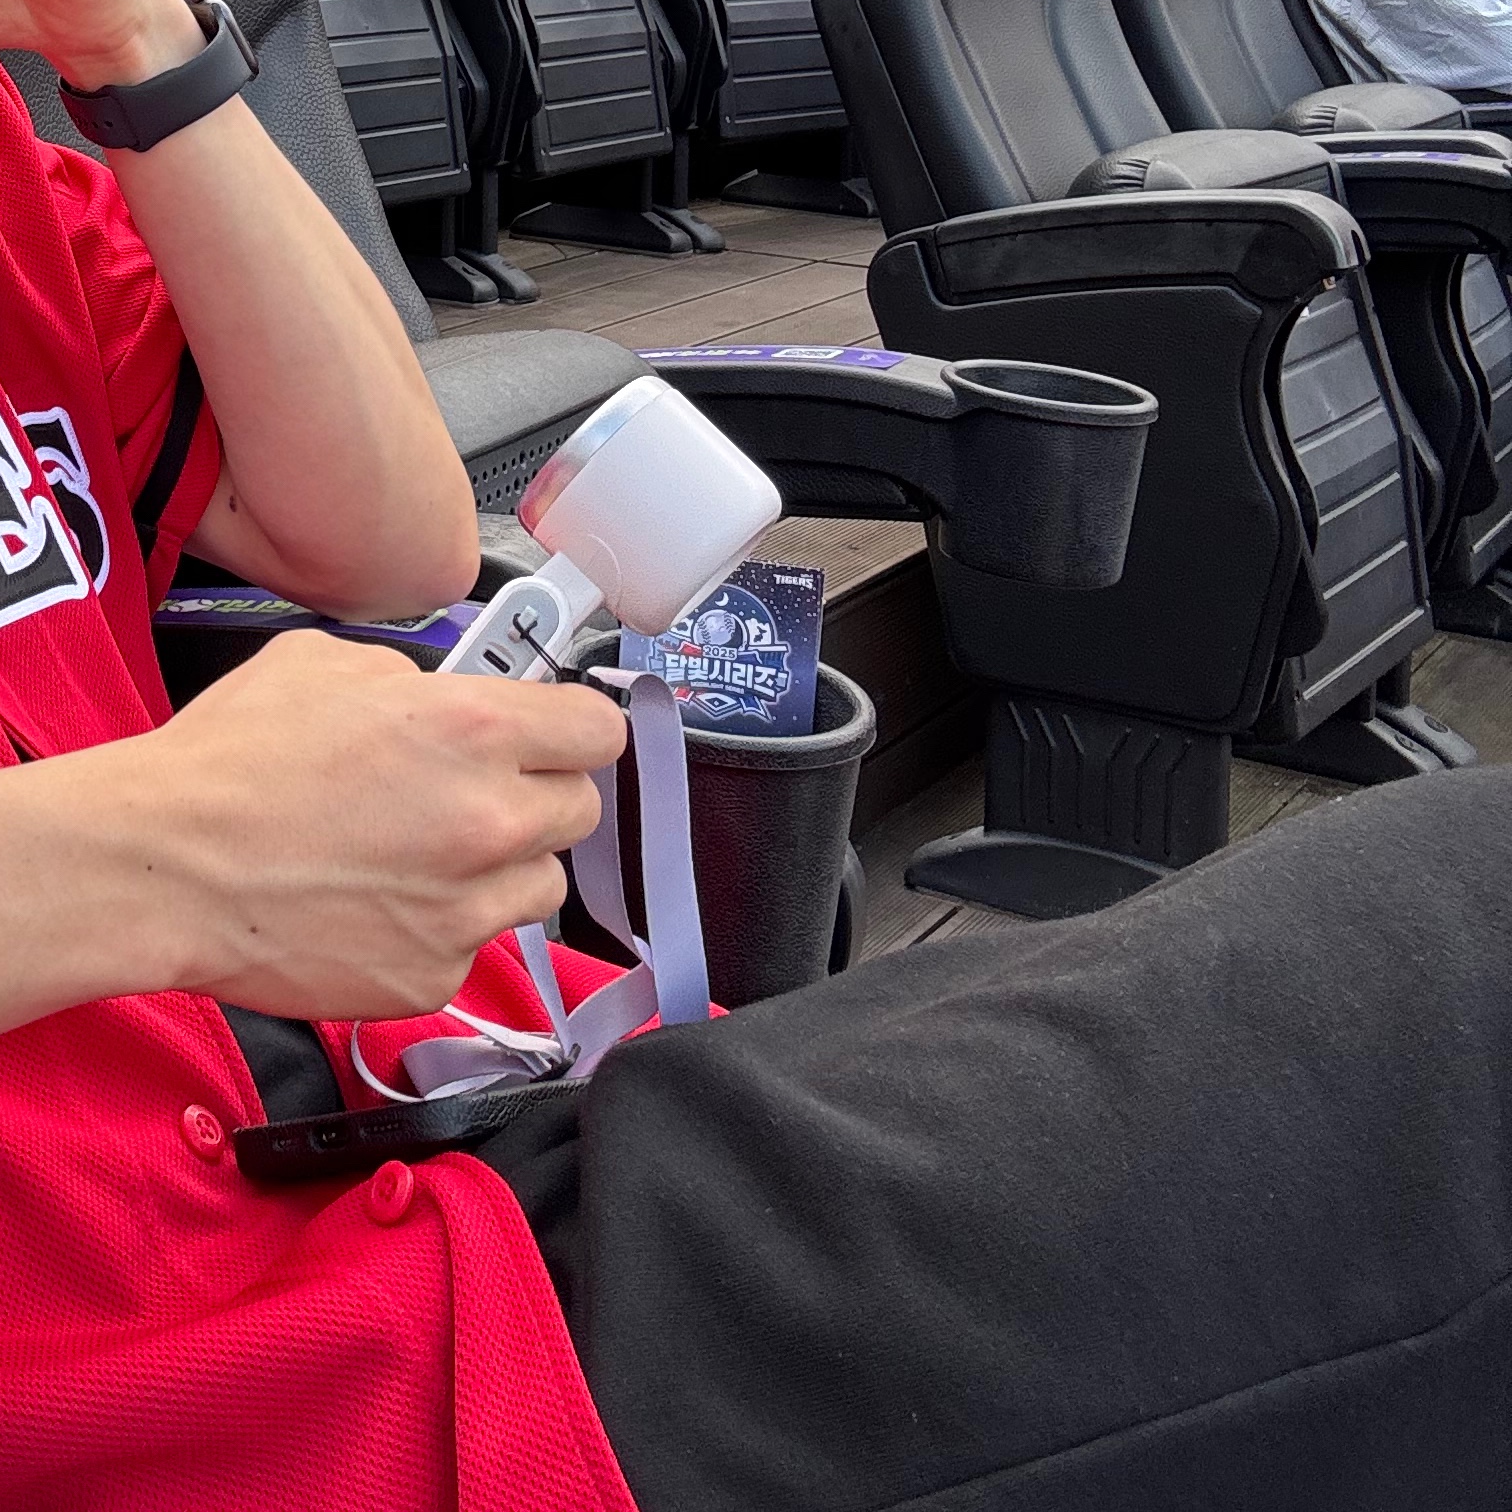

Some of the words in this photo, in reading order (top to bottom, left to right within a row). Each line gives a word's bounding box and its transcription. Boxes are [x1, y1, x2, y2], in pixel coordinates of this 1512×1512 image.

[773, 574, 814, 589] TIGERS
[704, 646, 736, 659] 2025
[665, 653, 777, 698] 달빛시리즈
